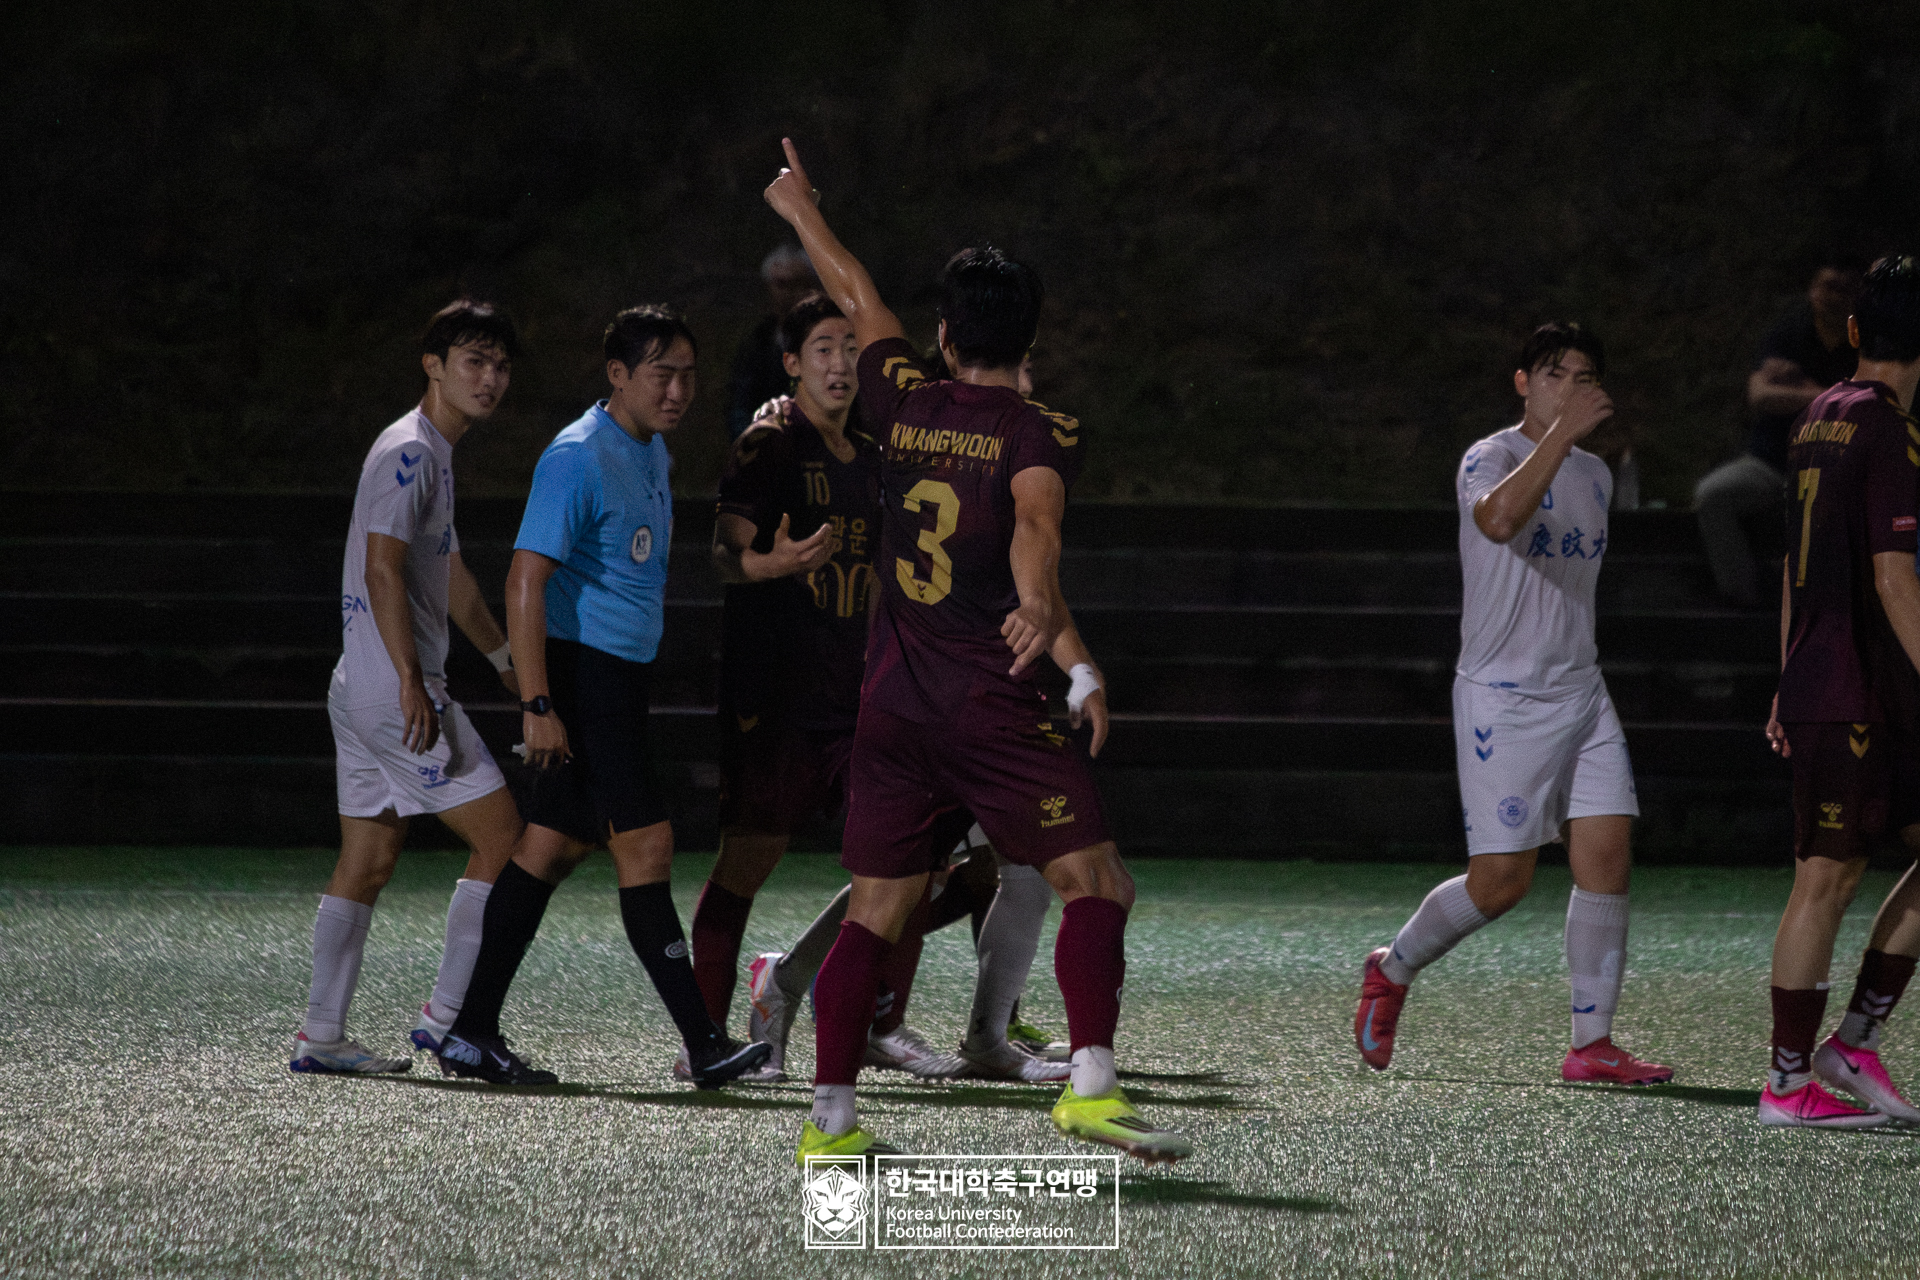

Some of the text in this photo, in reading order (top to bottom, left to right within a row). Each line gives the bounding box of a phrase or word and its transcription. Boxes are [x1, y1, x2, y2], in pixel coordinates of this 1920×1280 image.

[890, 422, 1004, 461] KWANGWOON
[803, 470, 830, 506] 10
[829, 515, 868, 556] 광운
[896, 479, 961, 606] 3
[1796, 467, 1821, 588] 7
